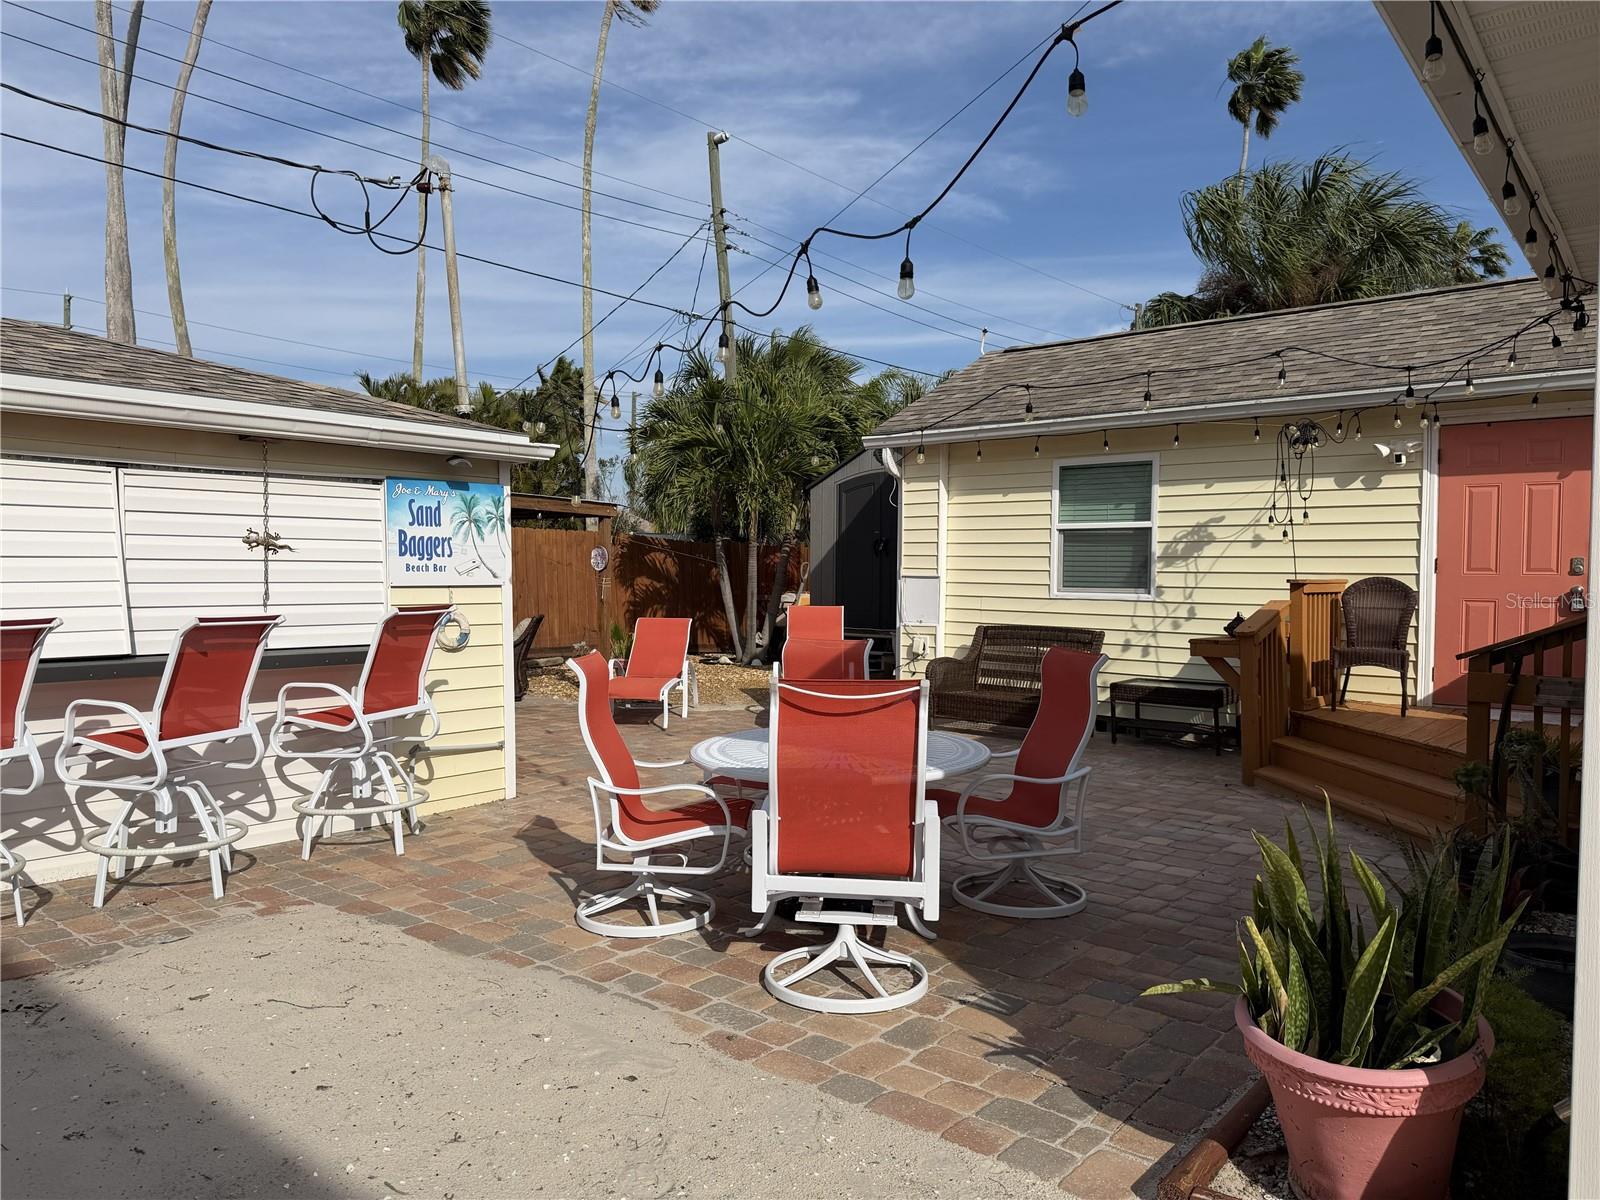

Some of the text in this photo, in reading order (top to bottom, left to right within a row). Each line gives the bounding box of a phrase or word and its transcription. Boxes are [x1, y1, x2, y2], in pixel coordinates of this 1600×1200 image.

[392, 483, 456, 505] Joe & Mary's
[408, 498, 442, 527] Sand
[398, 529, 453, 561] Baggers
[405, 563, 447, 573] Beach Bar
